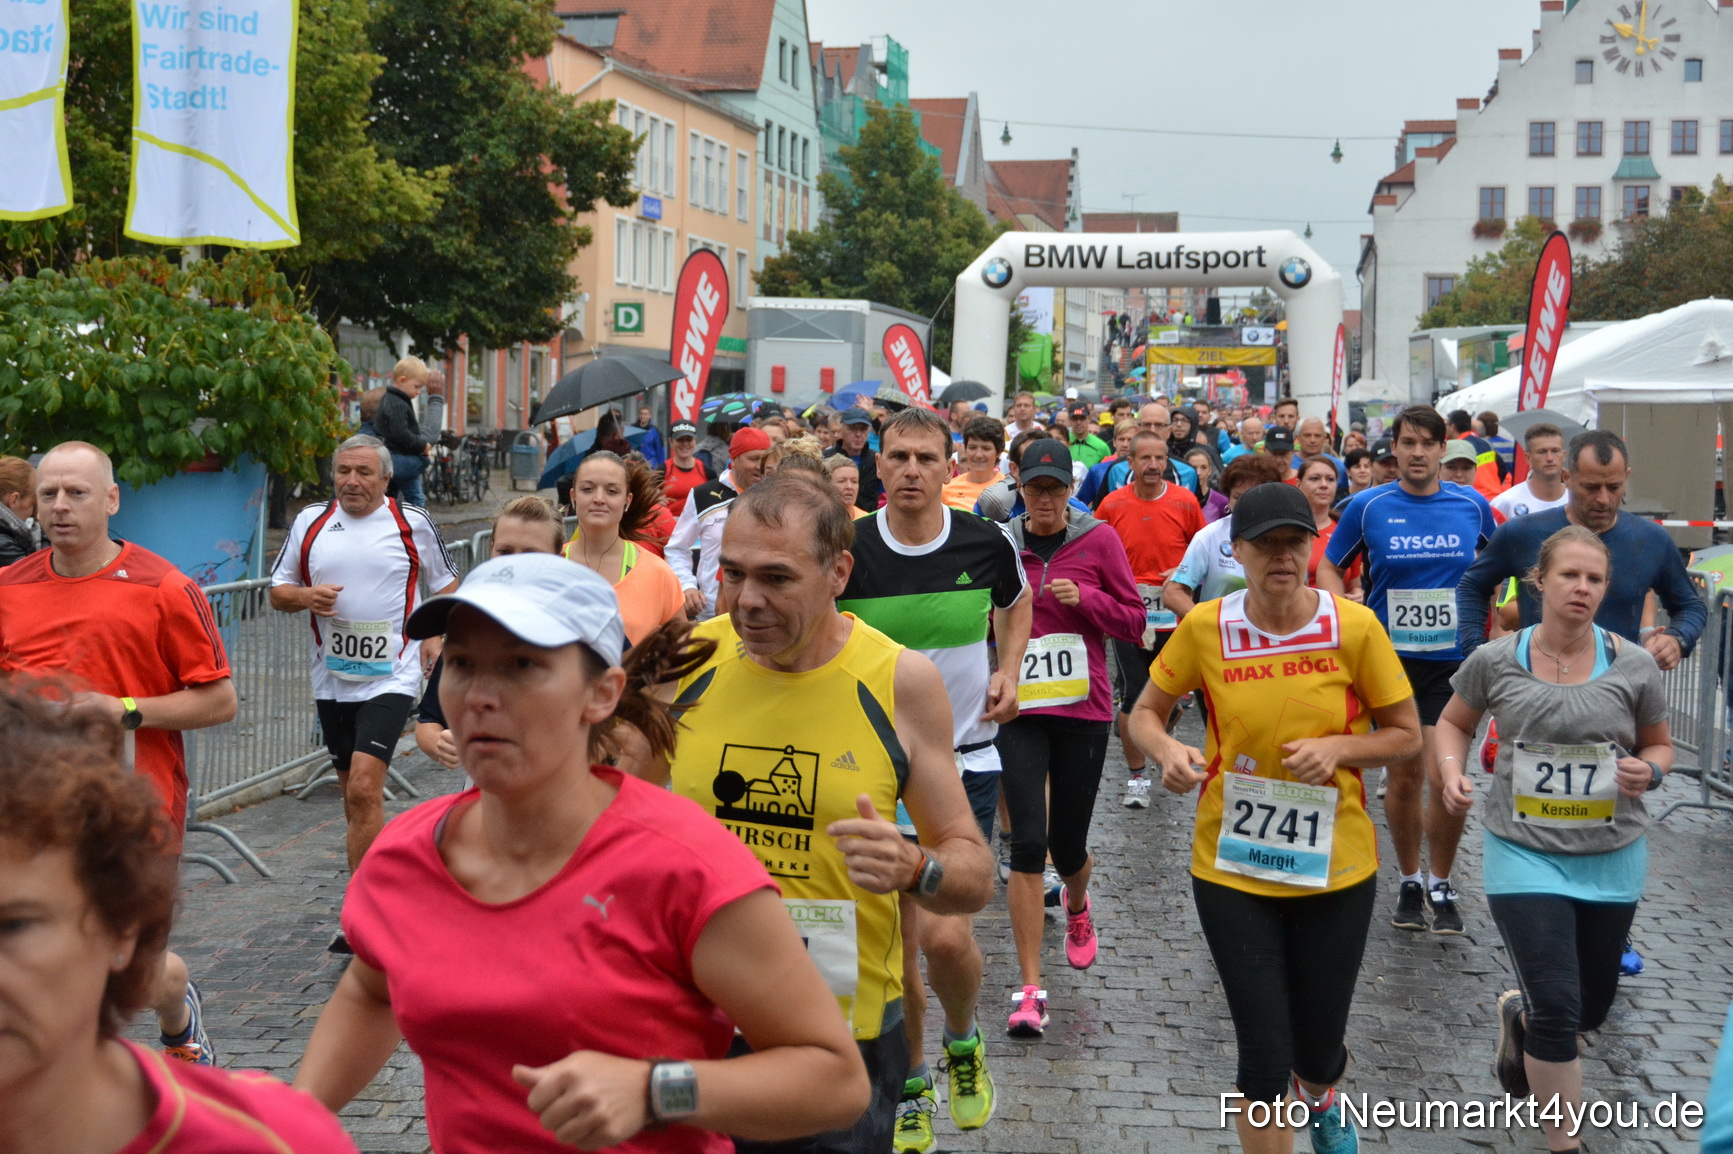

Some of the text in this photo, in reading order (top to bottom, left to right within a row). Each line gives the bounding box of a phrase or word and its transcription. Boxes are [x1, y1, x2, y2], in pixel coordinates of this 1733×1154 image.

[140, 3, 259, 36] Wir sind
[141, 43, 280, 77] Fairtrade-
[146, 83, 228, 110] Stadt!
[1024, 244, 1267, 274] BMW Laufsport
[618, 306, 639, 329] D
[674, 271, 720, 420] REWE
[1523, 260, 1566, 411] REWE
[1198, 351, 1226, 361] ZIEL
[672, 424, 696, 432] adidas
[1389, 534, 1460, 550] SYSCAD
[1386, 551, 1464, 560] www.metallbau-cad.de
[1147, 614, 1160, 622] eter
[1395, 604, 1451, 627] 2395
[332, 632, 387, 658] 3062
[1409, 633, 1438, 643] Fabian
[1024, 650, 1072, 680] 210
[1223, 656, 1339, 683] MAX BÖGL
[831, 761, 860, 772] adidas
[1535, 762, 1597, 795] 217
[1232, 784, 1266, 796] NeuerMarkt
[1272, 783, 1327, 802] BOCK
[1541, 802, 1588, 816] Kerstin
[1233, 799, 1319, 847] 2741
[724, 823, 811, 852] IRSCH
[764, 860, 809, 871] HEKE
[1249, 848, 1296, 870] Margit
[785, 905, 844, 922] OCK
